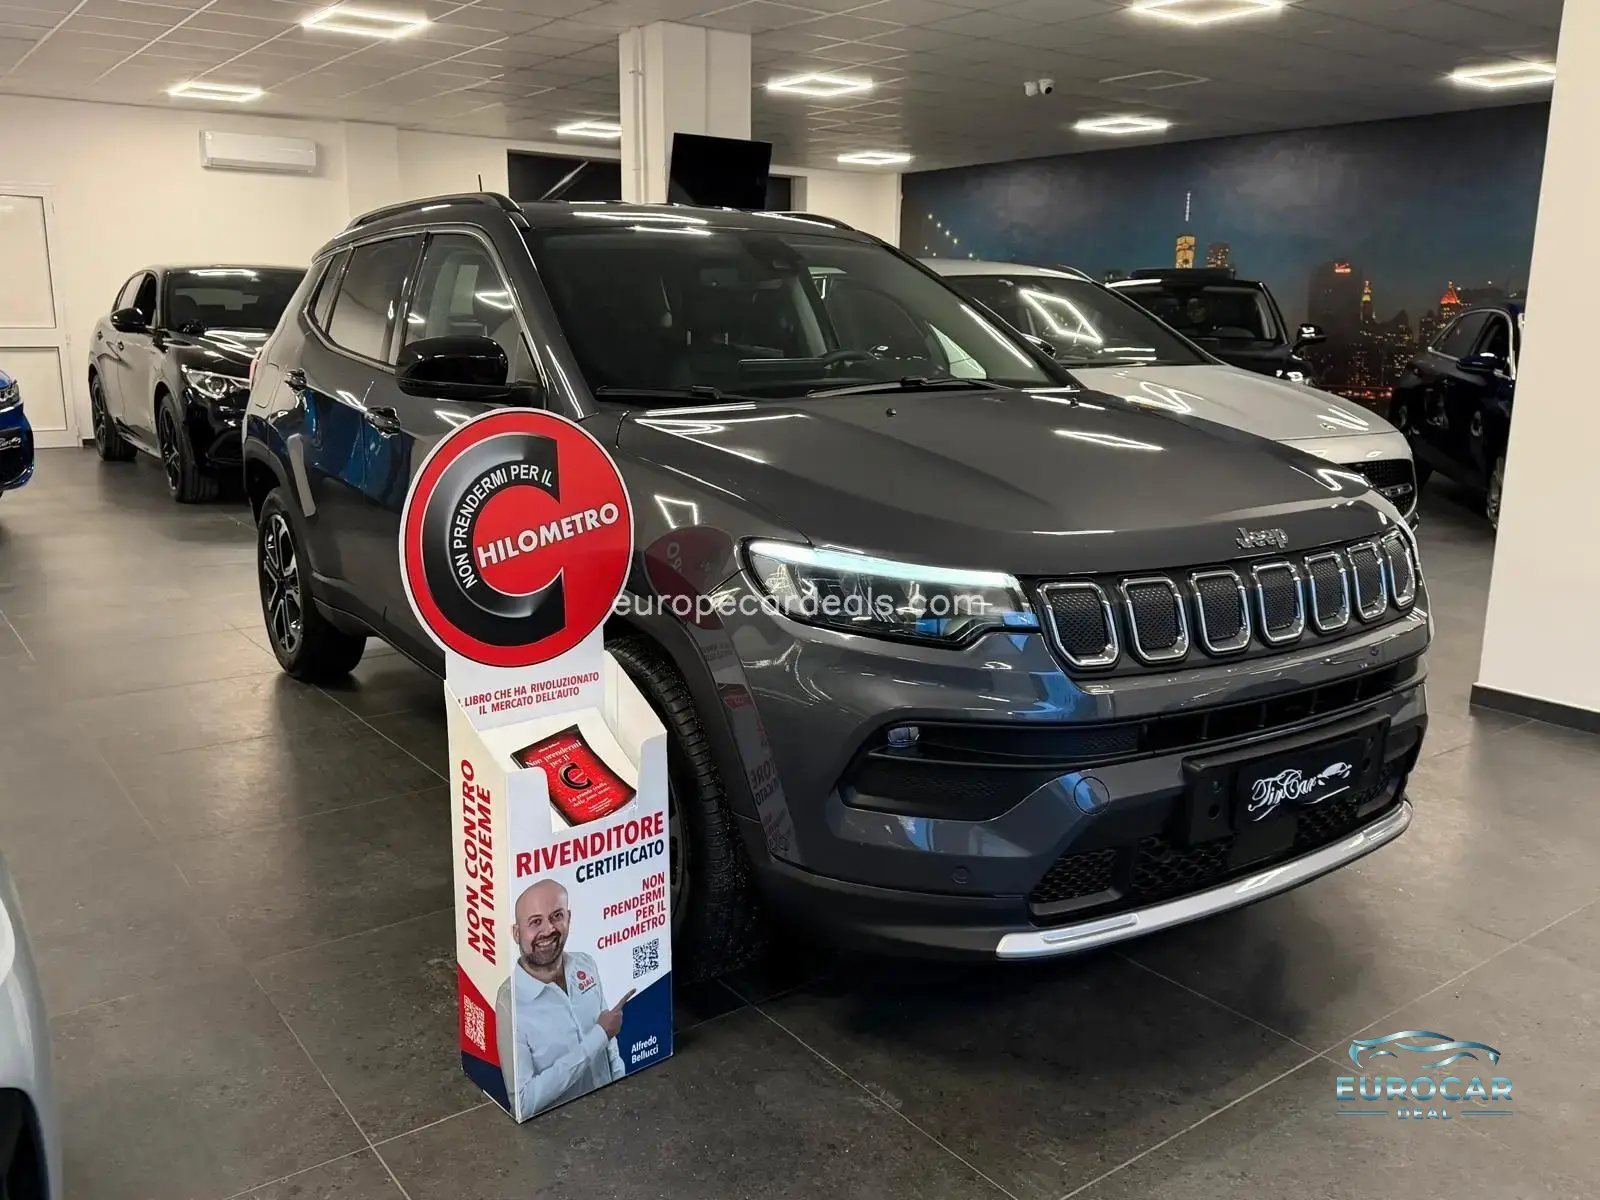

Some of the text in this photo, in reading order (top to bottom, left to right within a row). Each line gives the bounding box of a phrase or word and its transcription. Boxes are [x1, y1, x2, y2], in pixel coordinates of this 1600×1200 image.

[453, 464, 553, 589] NON PRENDERMI PER IL
[1236, 527, 1289, 549] Jeep
[464, 692, 492, 707] LIBRO
[494, 688, 512, 700] CHE
[514, 685, 527, 697] HA
[530, 671, 600, 693] RIVOLUZIONATO
[479, 686, 580, 715] IL MERCATO DELL'AUTO
[461, 759, 481, 954] NON CONTRO
[515, 811, 664, 878] RIVENDITORE
[575, 839, 665, 884] CERTIFICATO
[476, 784, 496, 967] MA INSIEME
[642, 872, 665, 891] NON
[603, 886, 665, 920] PRENDERMI
[635, 900, 666, 922] PER IL
[597, 914, 666, 950] CHILOMETRO
[631, 1035, 657, 1054] Alfredo
[631, 1044, 659, 1064] Bellucci
